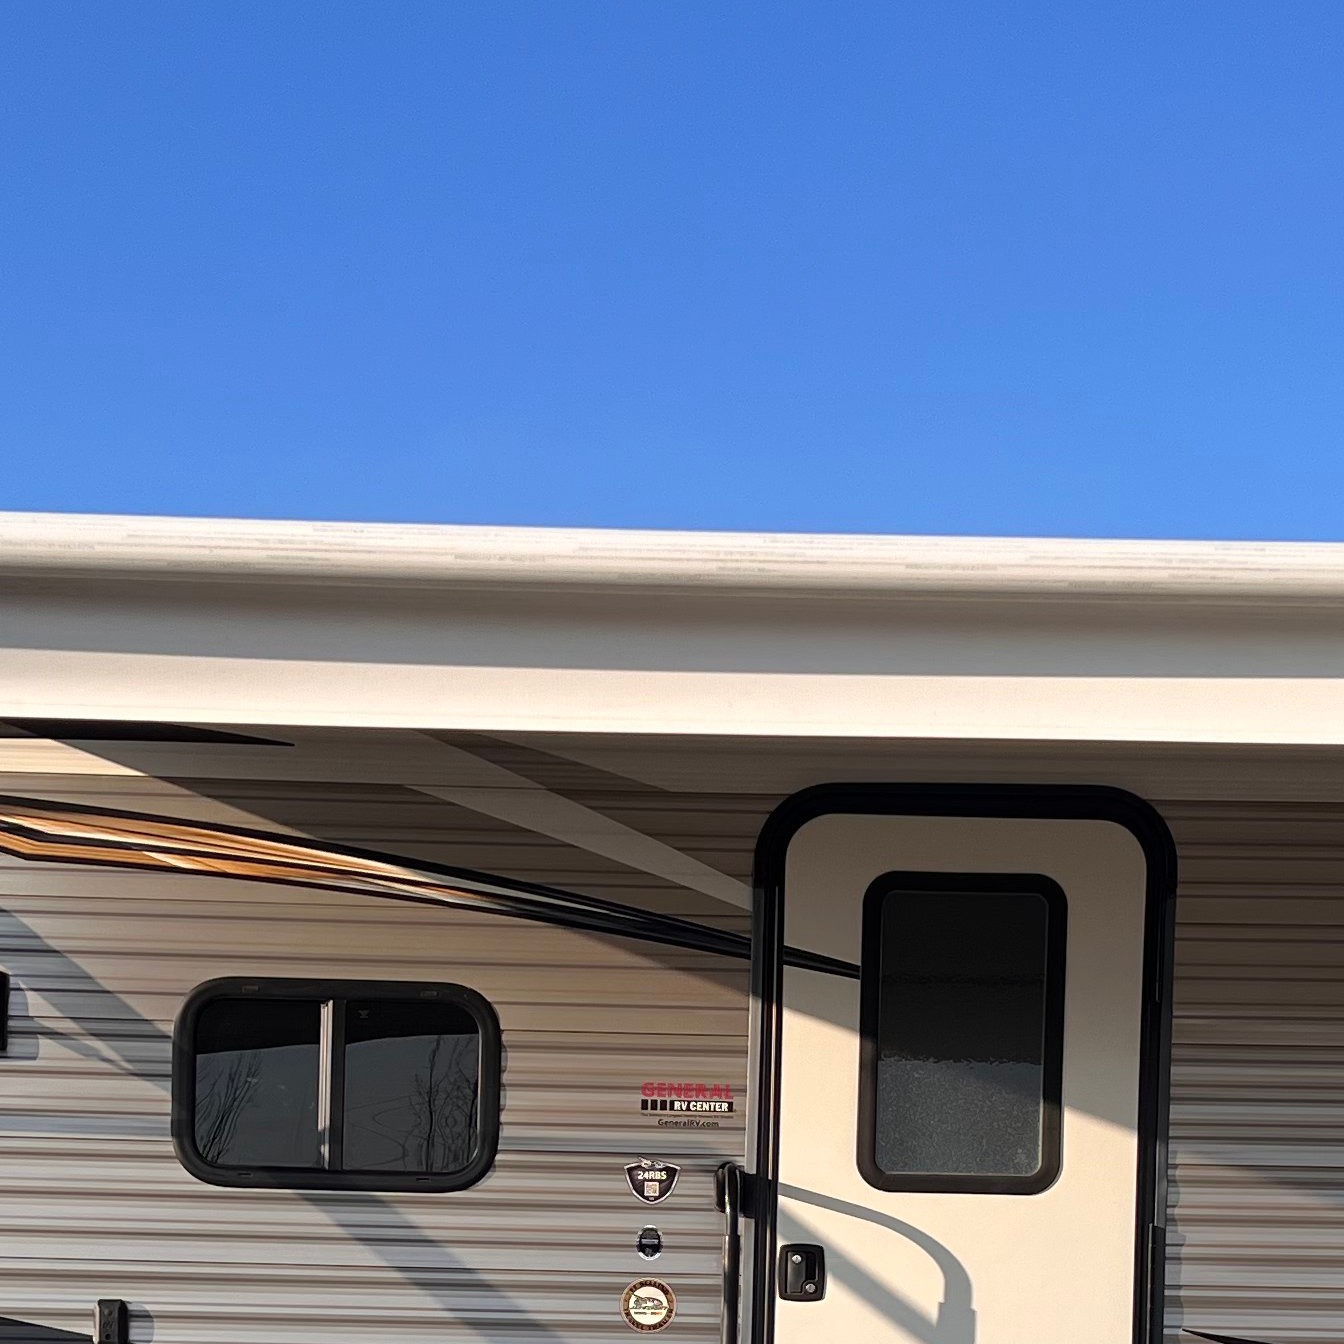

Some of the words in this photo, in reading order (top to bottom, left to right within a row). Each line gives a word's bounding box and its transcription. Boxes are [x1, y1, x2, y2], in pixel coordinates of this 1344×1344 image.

[641, 1082, 734, 1099] GENERAL
[674, 1101, 688, 1111] RV
[689, 1102, 729, 1112] CENTER
[658, 1119, 720, 1128] GeneralRV.com
[638, 1171, 667, 1180] 24RBS
